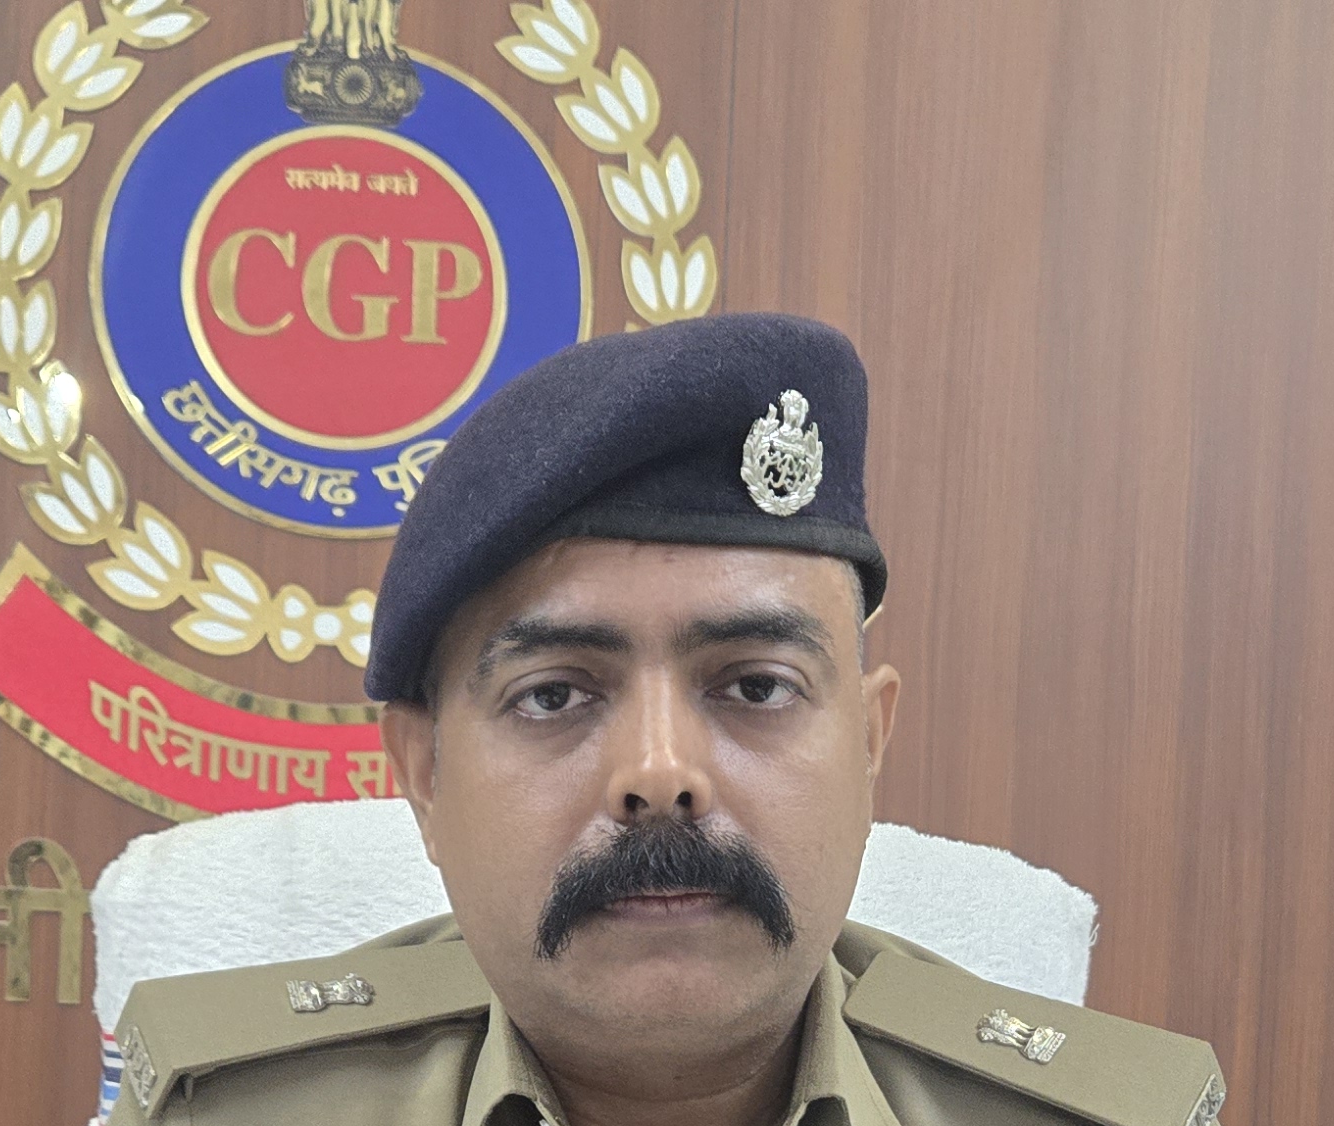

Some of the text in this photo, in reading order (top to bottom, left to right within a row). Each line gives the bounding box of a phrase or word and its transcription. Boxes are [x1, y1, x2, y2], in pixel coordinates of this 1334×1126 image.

[207, 228, 483, 345] CGP
[162, 379, 359, 518] छत्तीसगढ़
[88, 678, 330, 797] परित्राणाय
